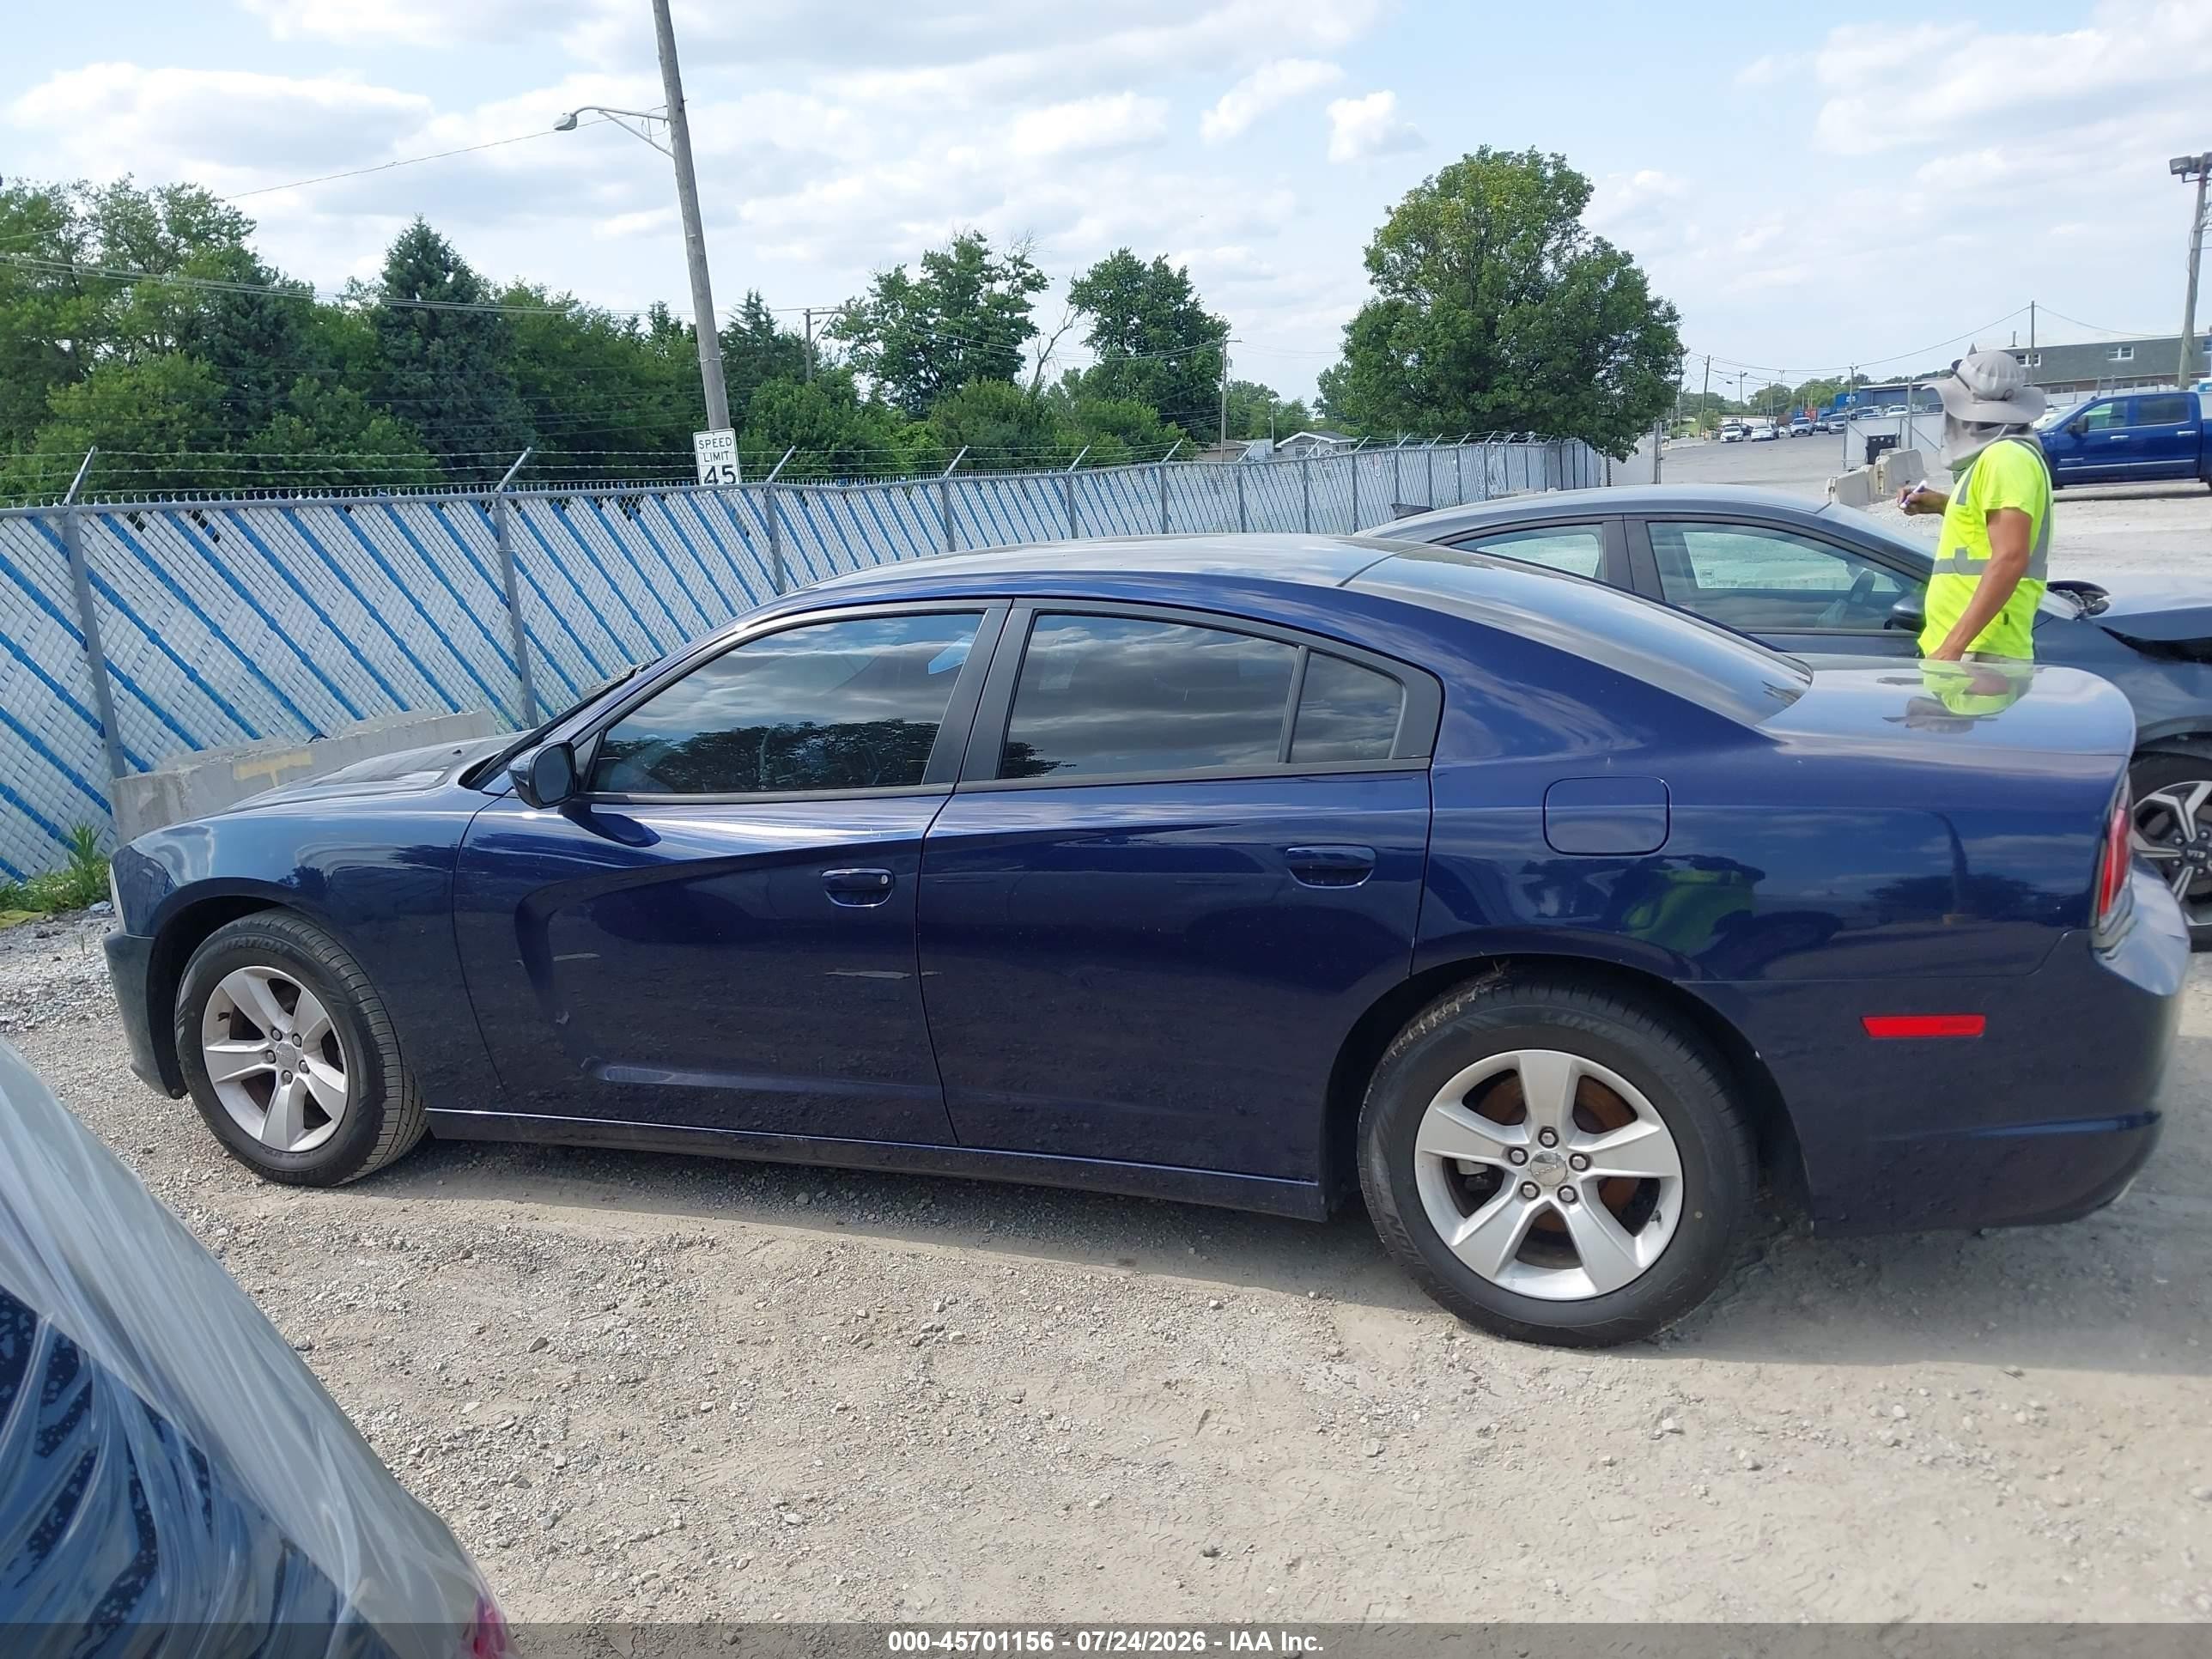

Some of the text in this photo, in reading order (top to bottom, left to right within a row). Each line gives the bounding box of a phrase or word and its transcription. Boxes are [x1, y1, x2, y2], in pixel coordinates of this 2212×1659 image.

[699, 437, 732, 449] SPEED
[703, 451, 728, 462] LIMIT
[704, 465, 736, 484] 45
